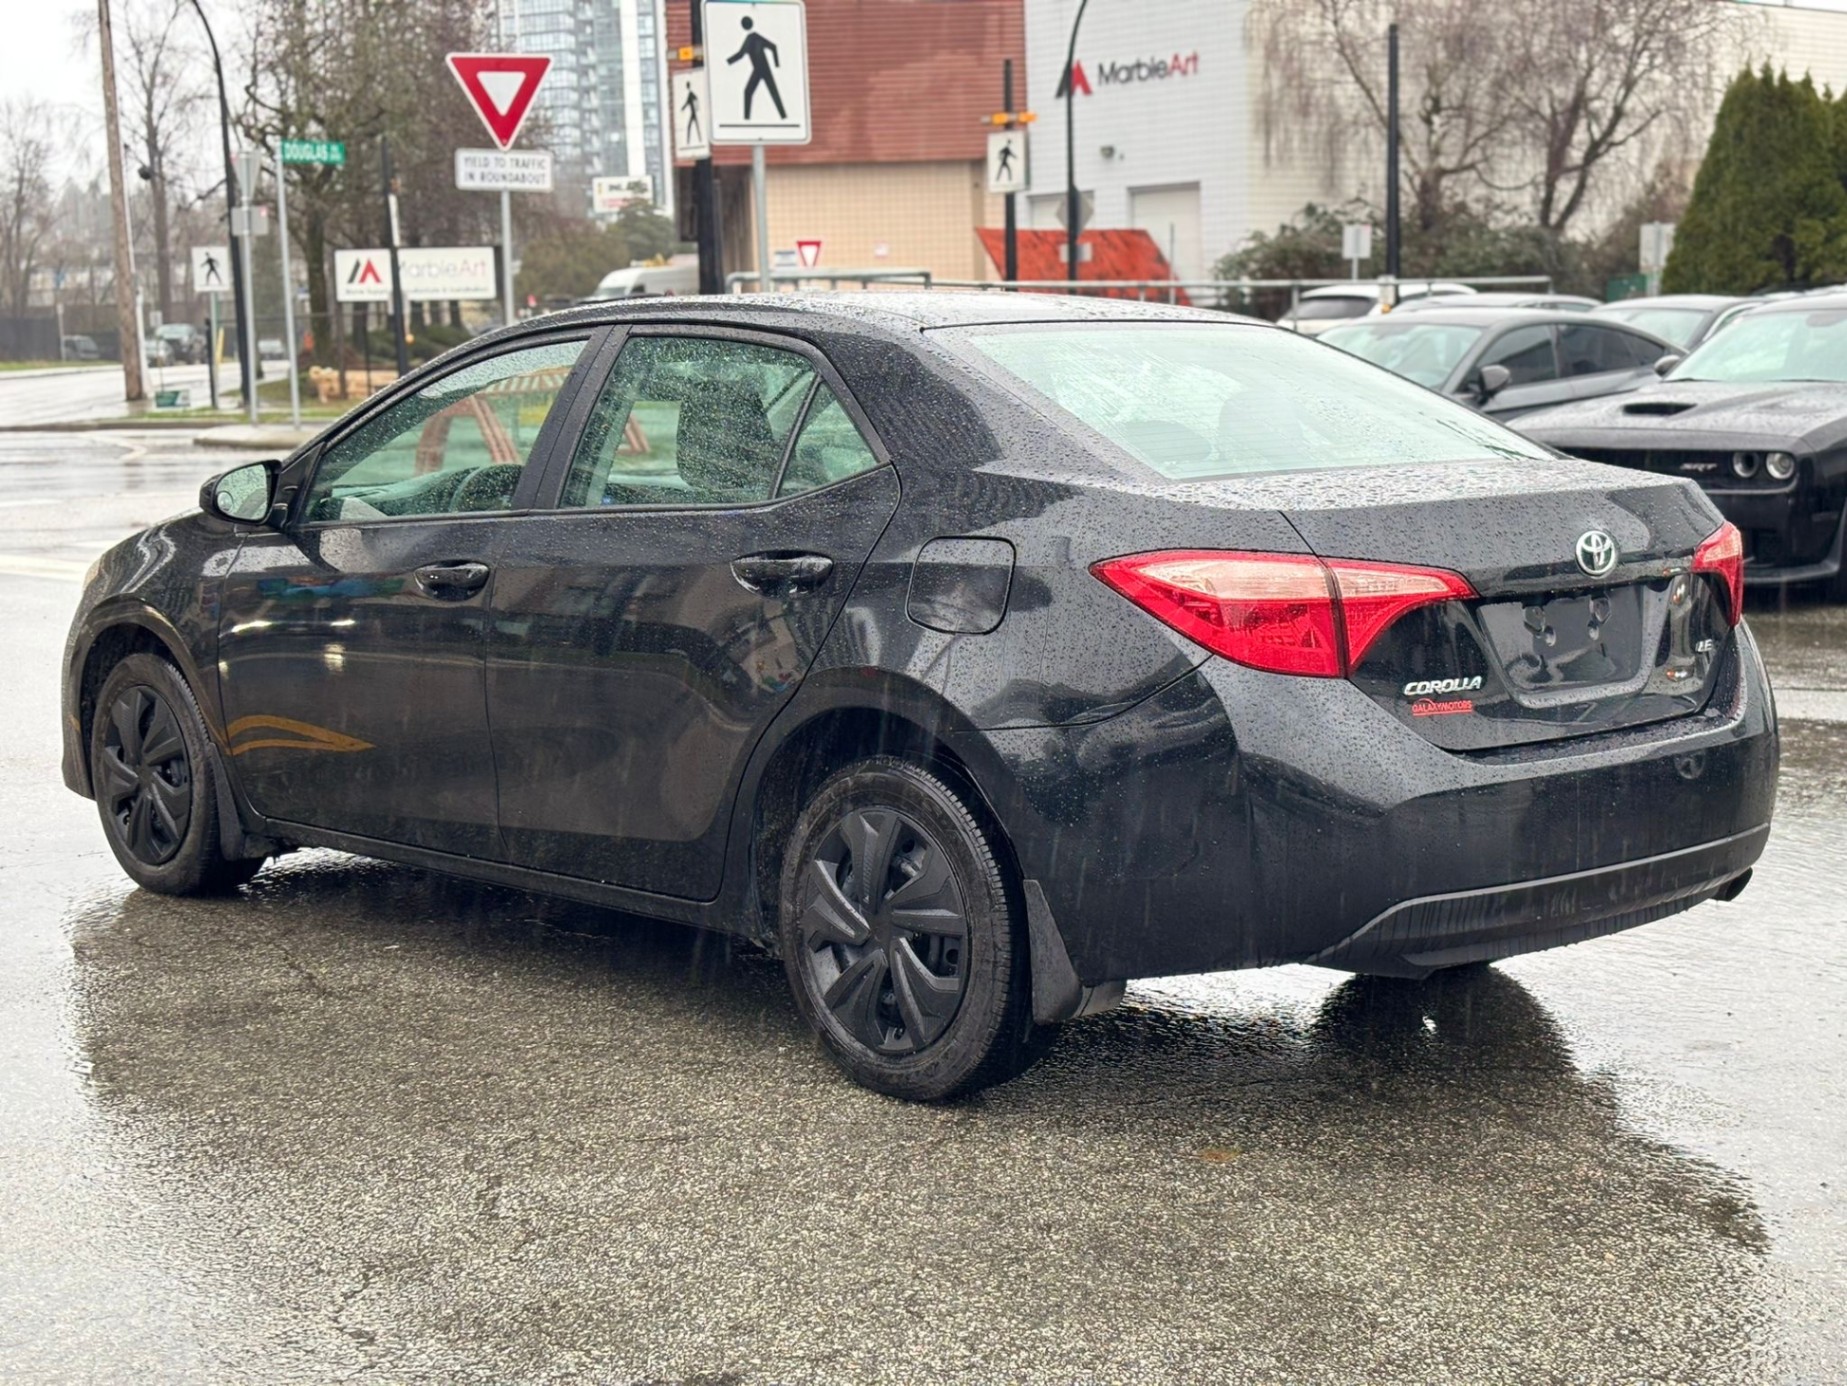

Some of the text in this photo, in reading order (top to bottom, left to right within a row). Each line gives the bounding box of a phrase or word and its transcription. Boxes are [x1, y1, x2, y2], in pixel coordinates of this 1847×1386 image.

[1098, 51, 1199, 86] MarbleArt
[284, 142, 328, 161] DOUGLAS
[464, 156, 546, 169] YIELD TO TRAFFIC
[465, 170, 546, 184] IN ROUNDABOUT
[1697, 639, 1712, 652] LE
[1403, 675, 1482, 695] COROLLA
